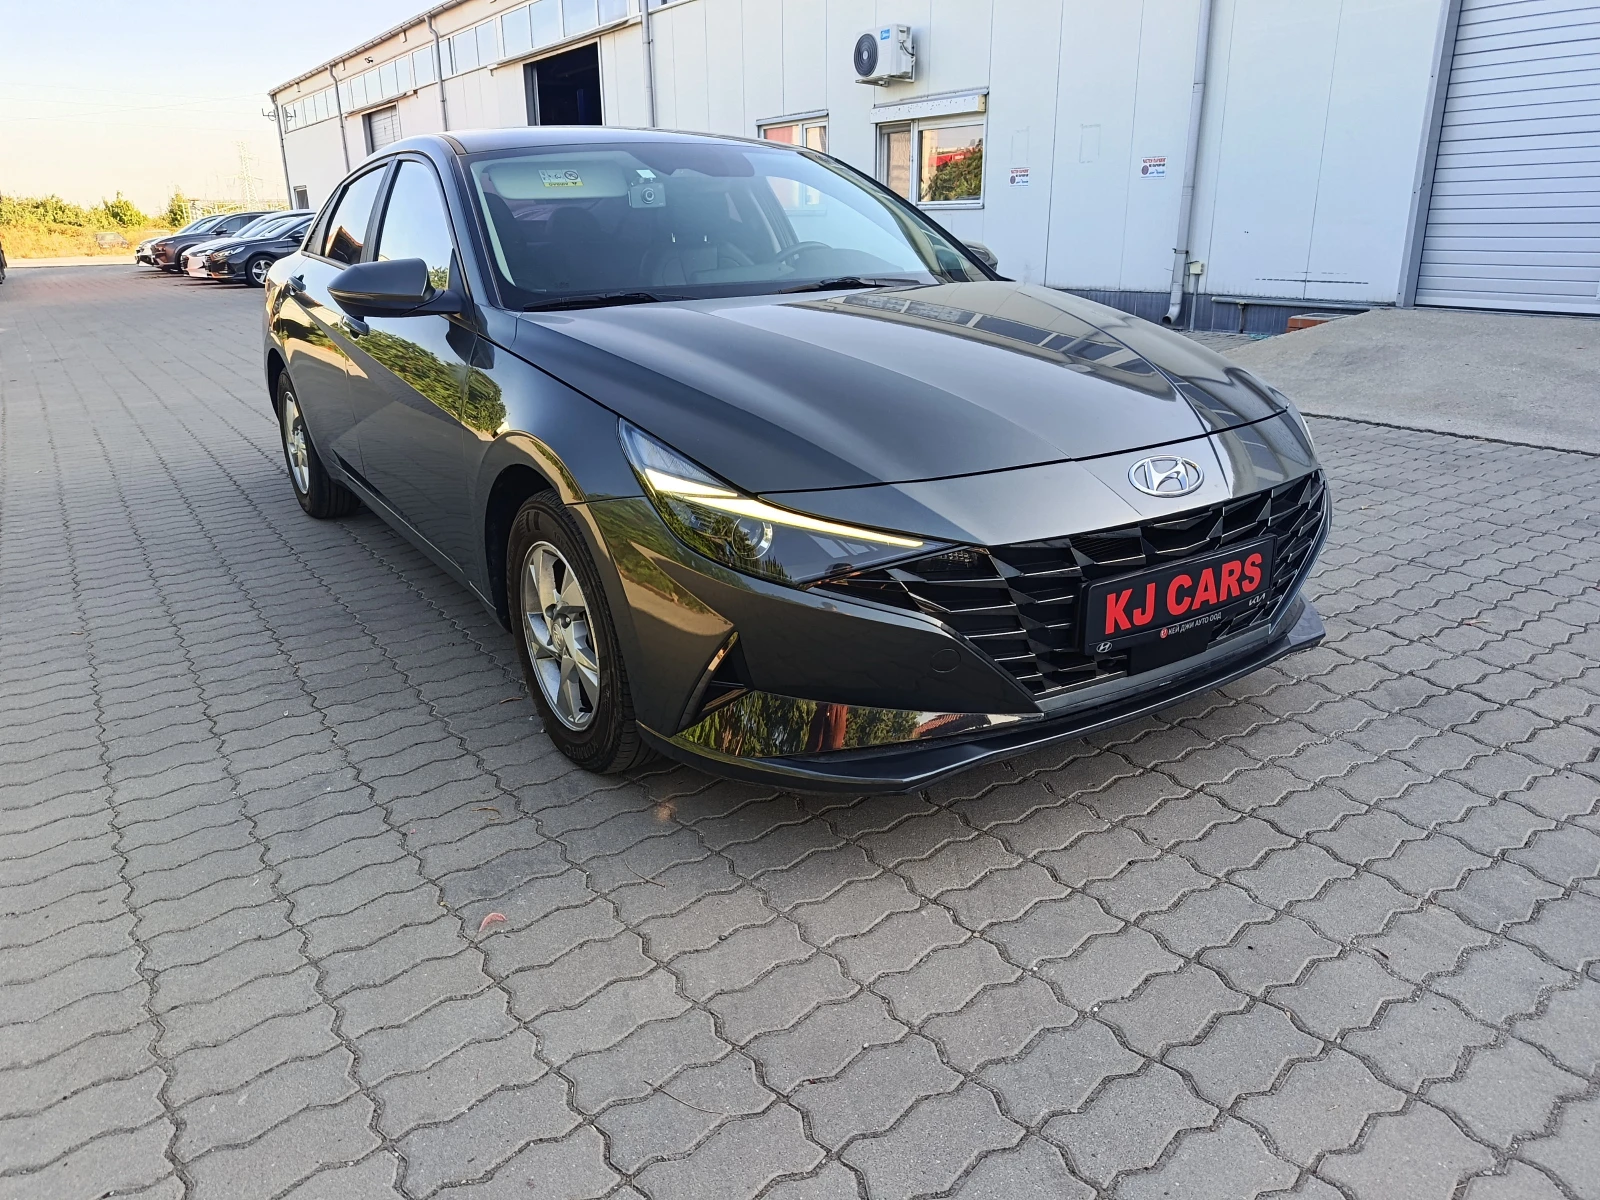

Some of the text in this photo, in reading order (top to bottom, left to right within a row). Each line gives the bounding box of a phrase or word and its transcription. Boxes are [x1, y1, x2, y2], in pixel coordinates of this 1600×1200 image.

[1105, 553, 1262, 635] KJ CARS
[1168, 625, 1180, 636] КЕЙ
[1180, 621, 1195, 634] ДЖИ
[1195, 616, 1209, 627] АУТО
[1209, 611, 1222, 622] ООД
